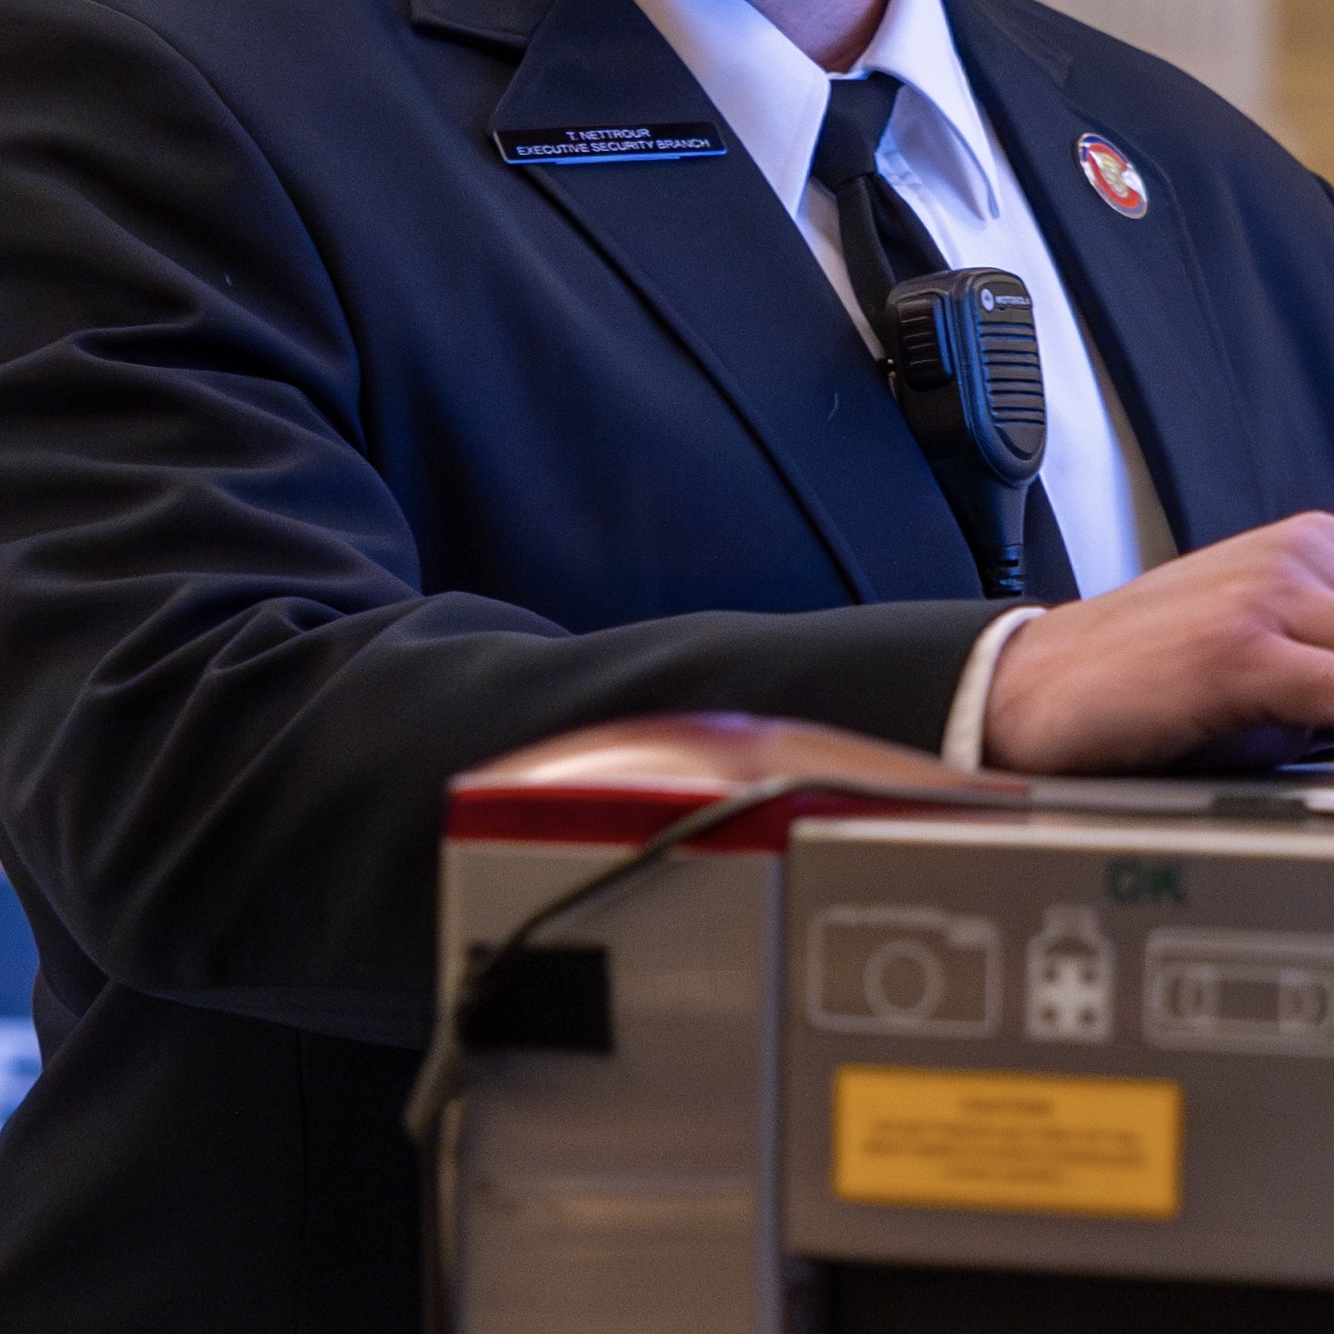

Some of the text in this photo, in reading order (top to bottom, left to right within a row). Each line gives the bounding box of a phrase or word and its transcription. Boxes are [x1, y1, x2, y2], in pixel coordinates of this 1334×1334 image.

[516, 138, 711, 156] EXECUTIVE SECURITY BRANCH
